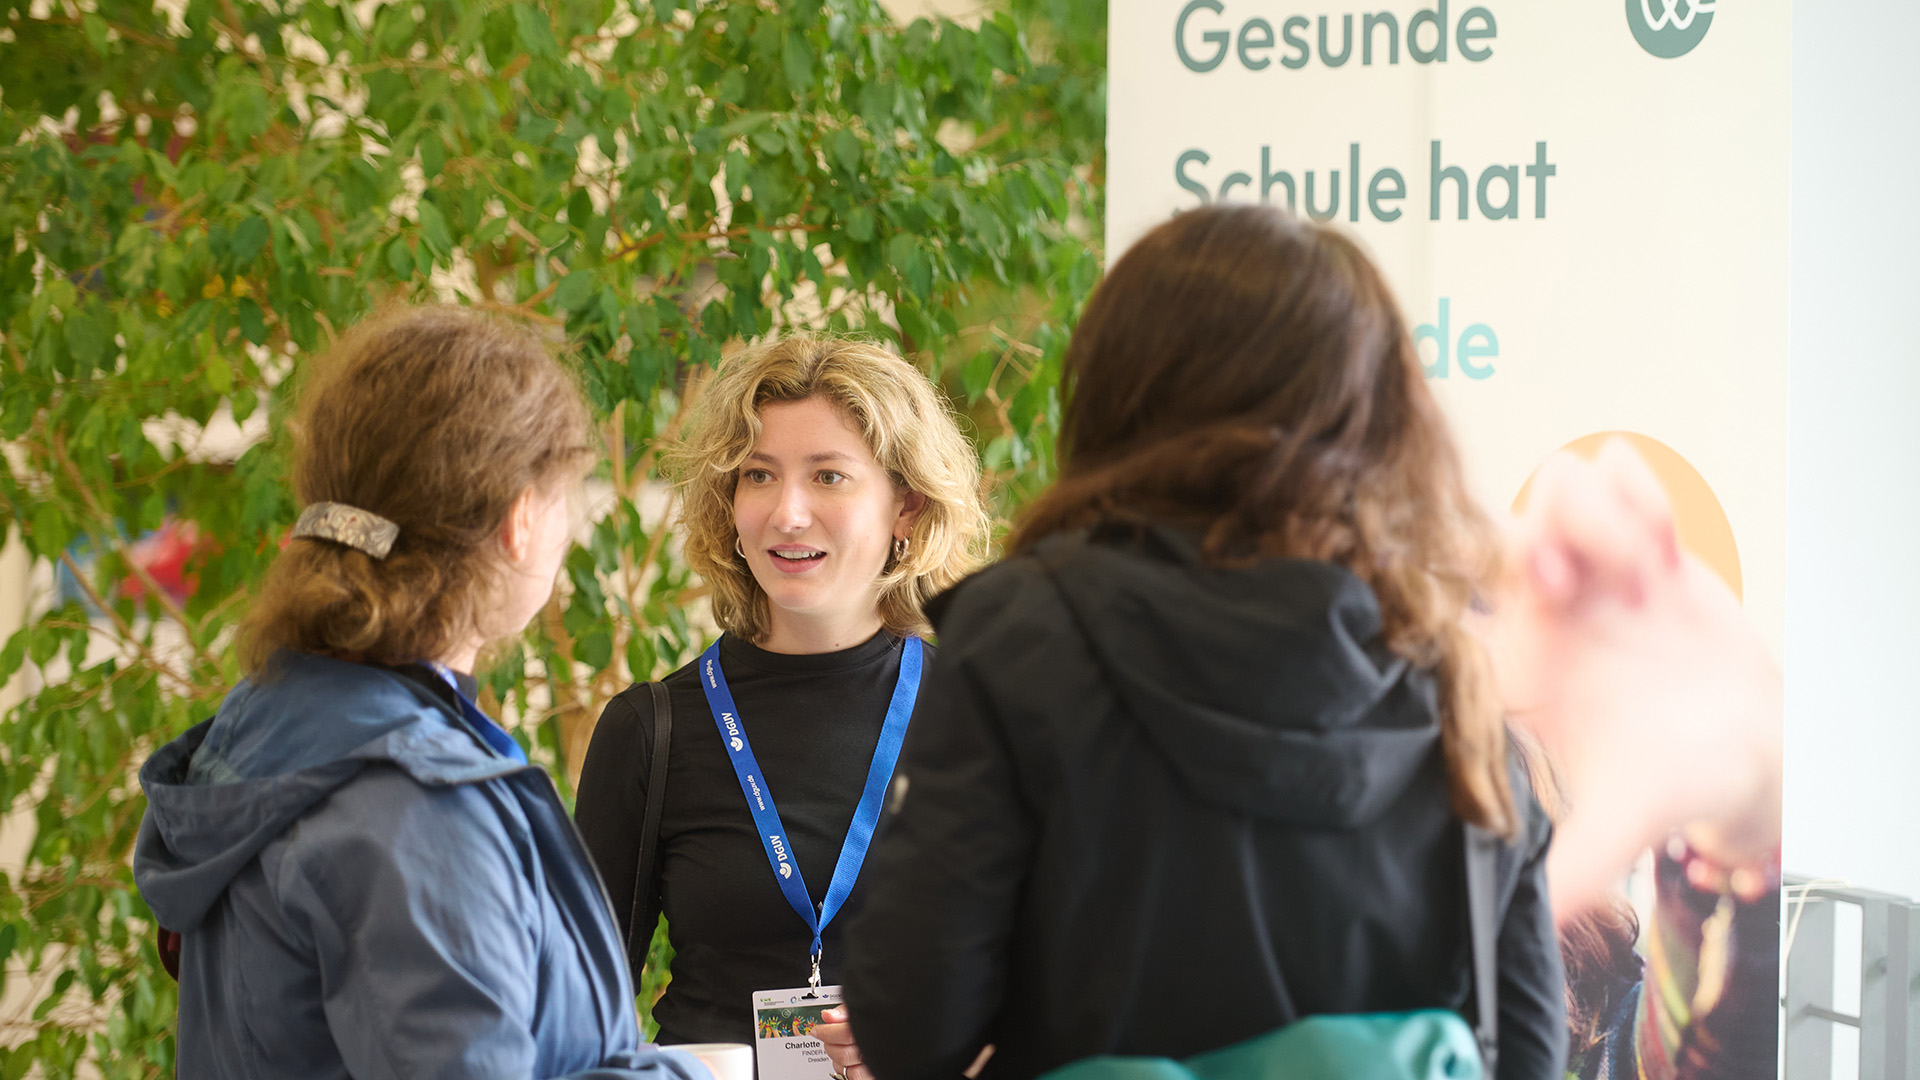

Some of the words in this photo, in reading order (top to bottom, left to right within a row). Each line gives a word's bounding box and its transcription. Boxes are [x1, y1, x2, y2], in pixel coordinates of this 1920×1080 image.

[1174, 0, 1498, 73] Gesunde
[1430, 140, 1557, 220] hat
[721, 712, 740, 737] DGUV
[769, 835, 788, 862] DGUV
[785, 1041, 821, 1050] Charlotte
